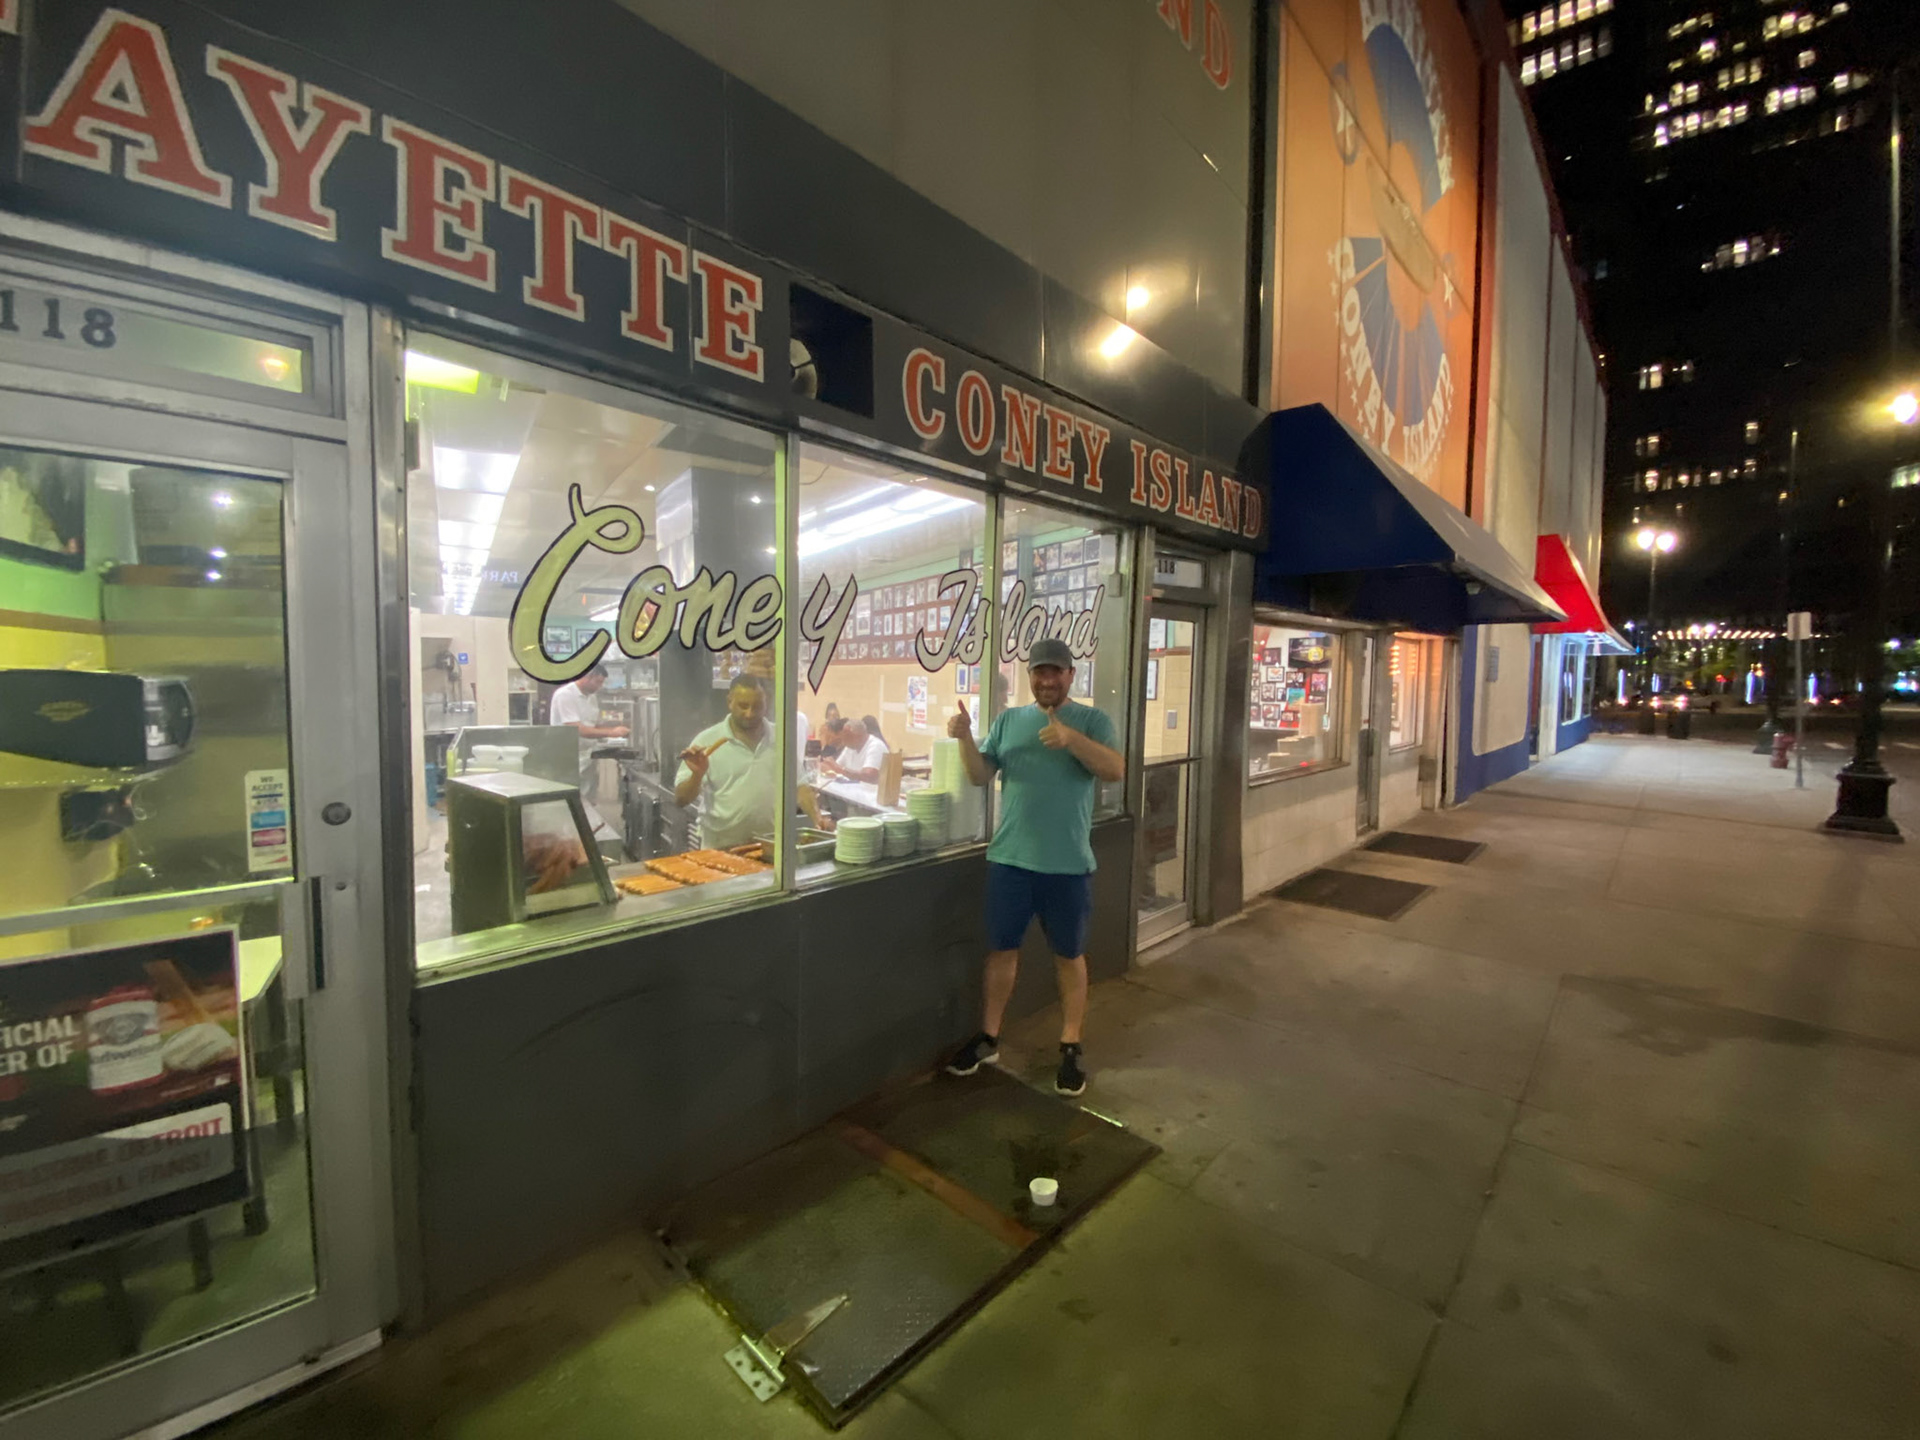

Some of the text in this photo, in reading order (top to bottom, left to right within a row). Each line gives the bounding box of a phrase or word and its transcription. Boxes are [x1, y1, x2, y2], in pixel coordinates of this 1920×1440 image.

[0, 0, 1263, 540] AYETTE CONEY ISLAND
[509, 483, 1105, 696] Coney Island
[0, 1014, 82, 1049] ICIAL
[36, 1041, 75, 1069] OF
